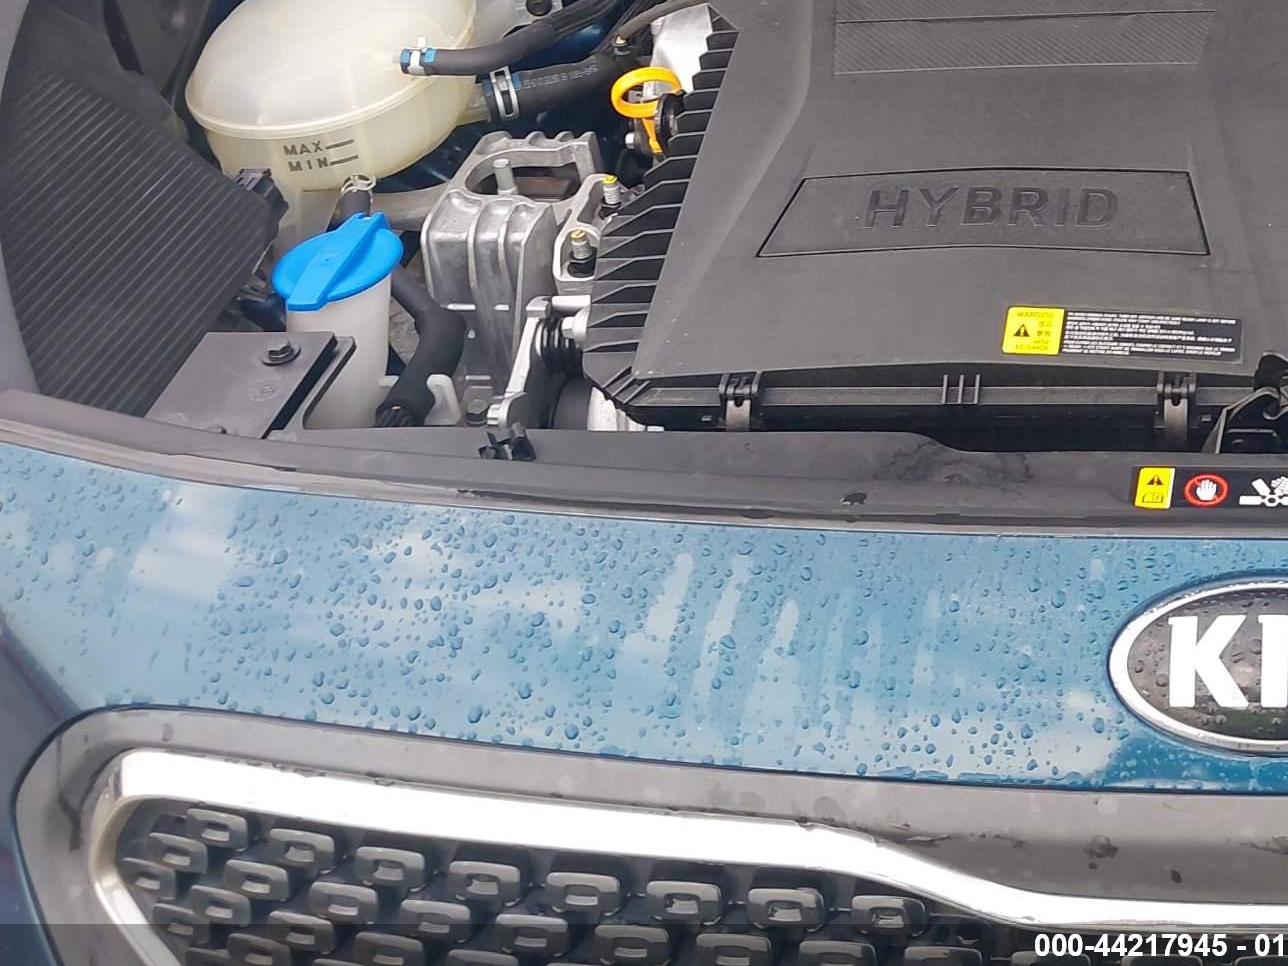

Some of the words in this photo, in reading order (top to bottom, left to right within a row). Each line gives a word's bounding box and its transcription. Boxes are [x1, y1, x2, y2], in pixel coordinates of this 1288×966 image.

[283, 140, 323, 155] MAX
[288, 156, 328, 172] MIN
[864, 186, 1119, 228] HYBRID
